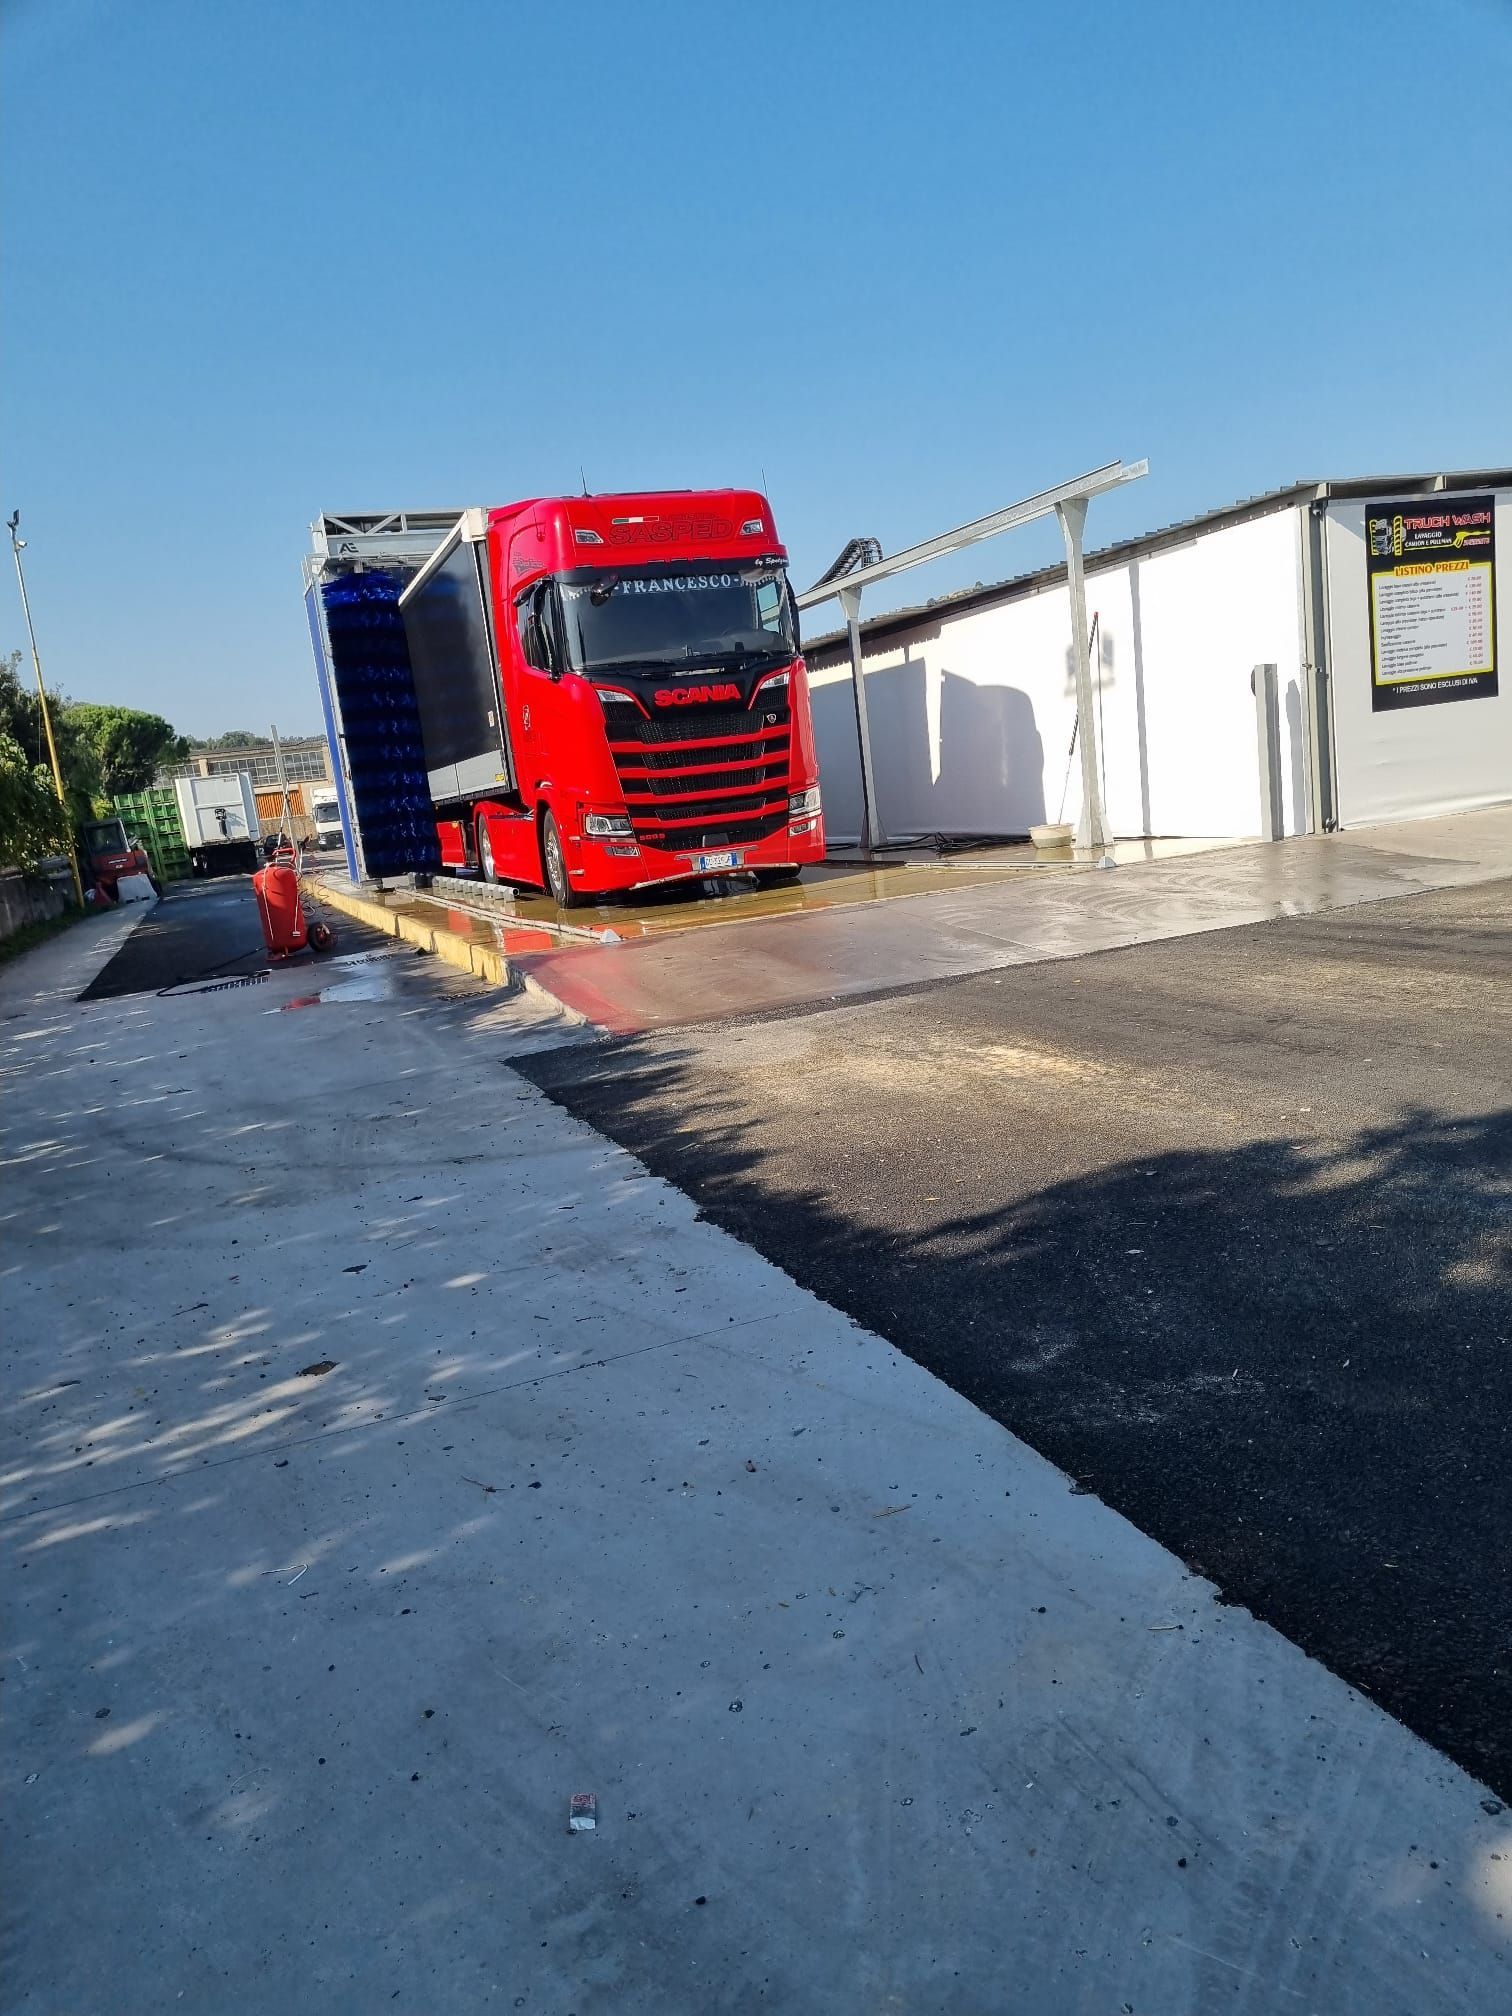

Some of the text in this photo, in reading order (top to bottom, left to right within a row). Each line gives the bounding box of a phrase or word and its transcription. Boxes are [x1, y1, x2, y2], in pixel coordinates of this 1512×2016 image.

[1452, 512, 1491, 526] WASH
[609, 519, 734, 544] SASPED
[1414, 531, 1442, 540] LAVAGGIO
[1395, 561, 1469, 577] LISTINO PREZZI
[1399, 684, 1420, 694] PREZZI
[1420, 683, 1437, 691] SONO
[1437, 679, 1462, 689] ESCLUSI
[1462, 678, 1468, 686] DI
[654, 683, 742, 707] SCANIA
